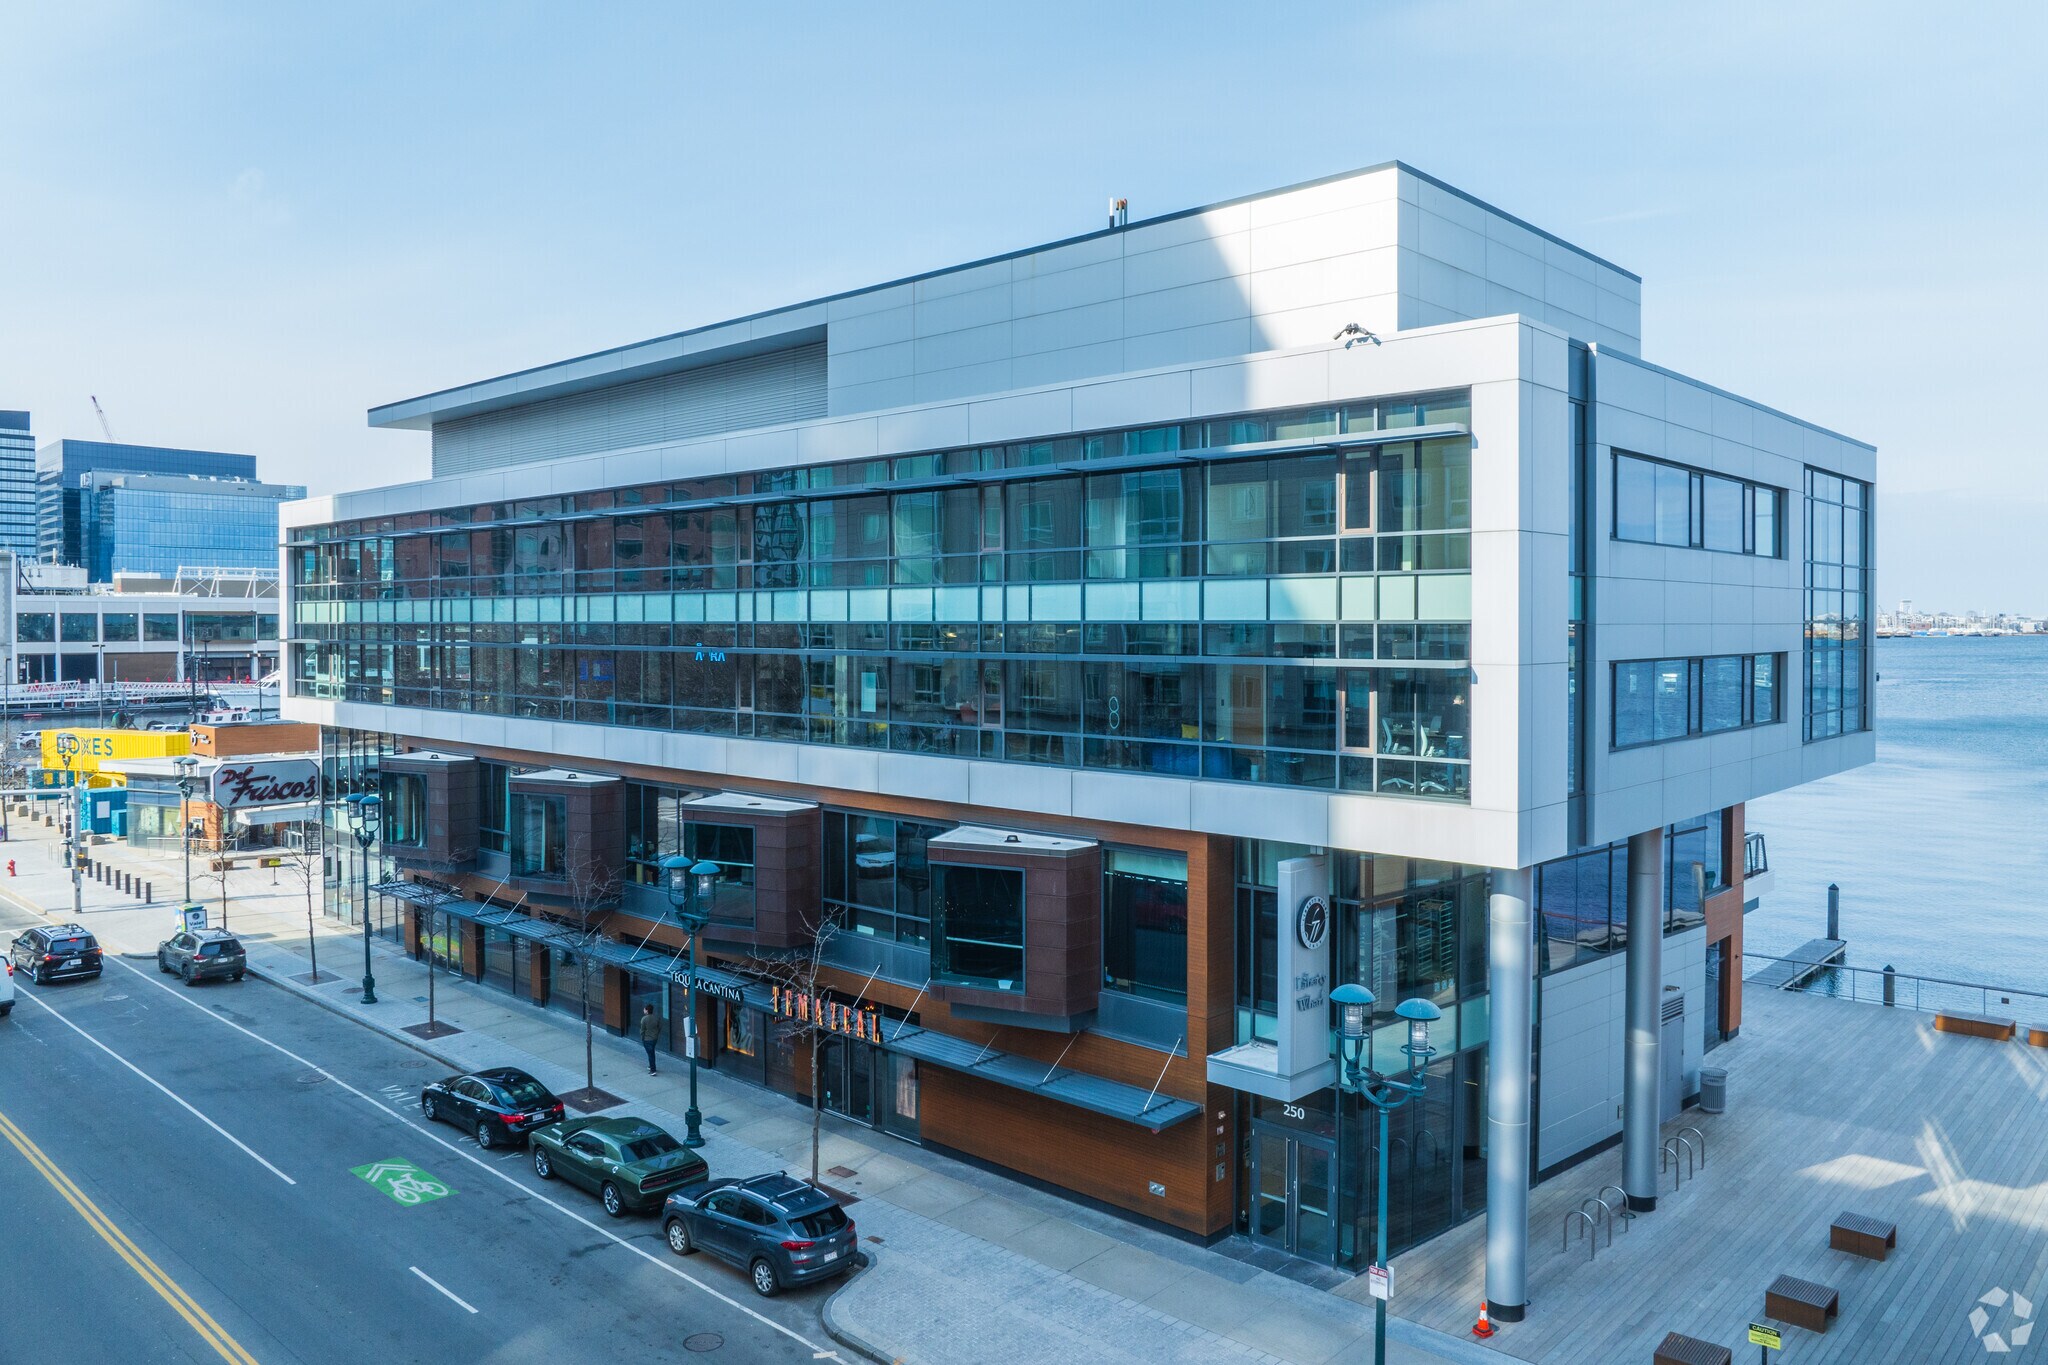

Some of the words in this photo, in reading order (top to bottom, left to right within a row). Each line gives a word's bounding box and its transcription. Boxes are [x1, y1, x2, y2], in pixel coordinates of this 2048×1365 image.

[220, 766, 254, 785] Del
[229, 775, 316, 805] Frisco's
[670, 970, 702, 990] TEQUA
[703, 981, 741, 1001] CANTINA
[1283, 1103, 1305, 1120] 250
[1752, 1325, 1778, 1336] CAUTION
